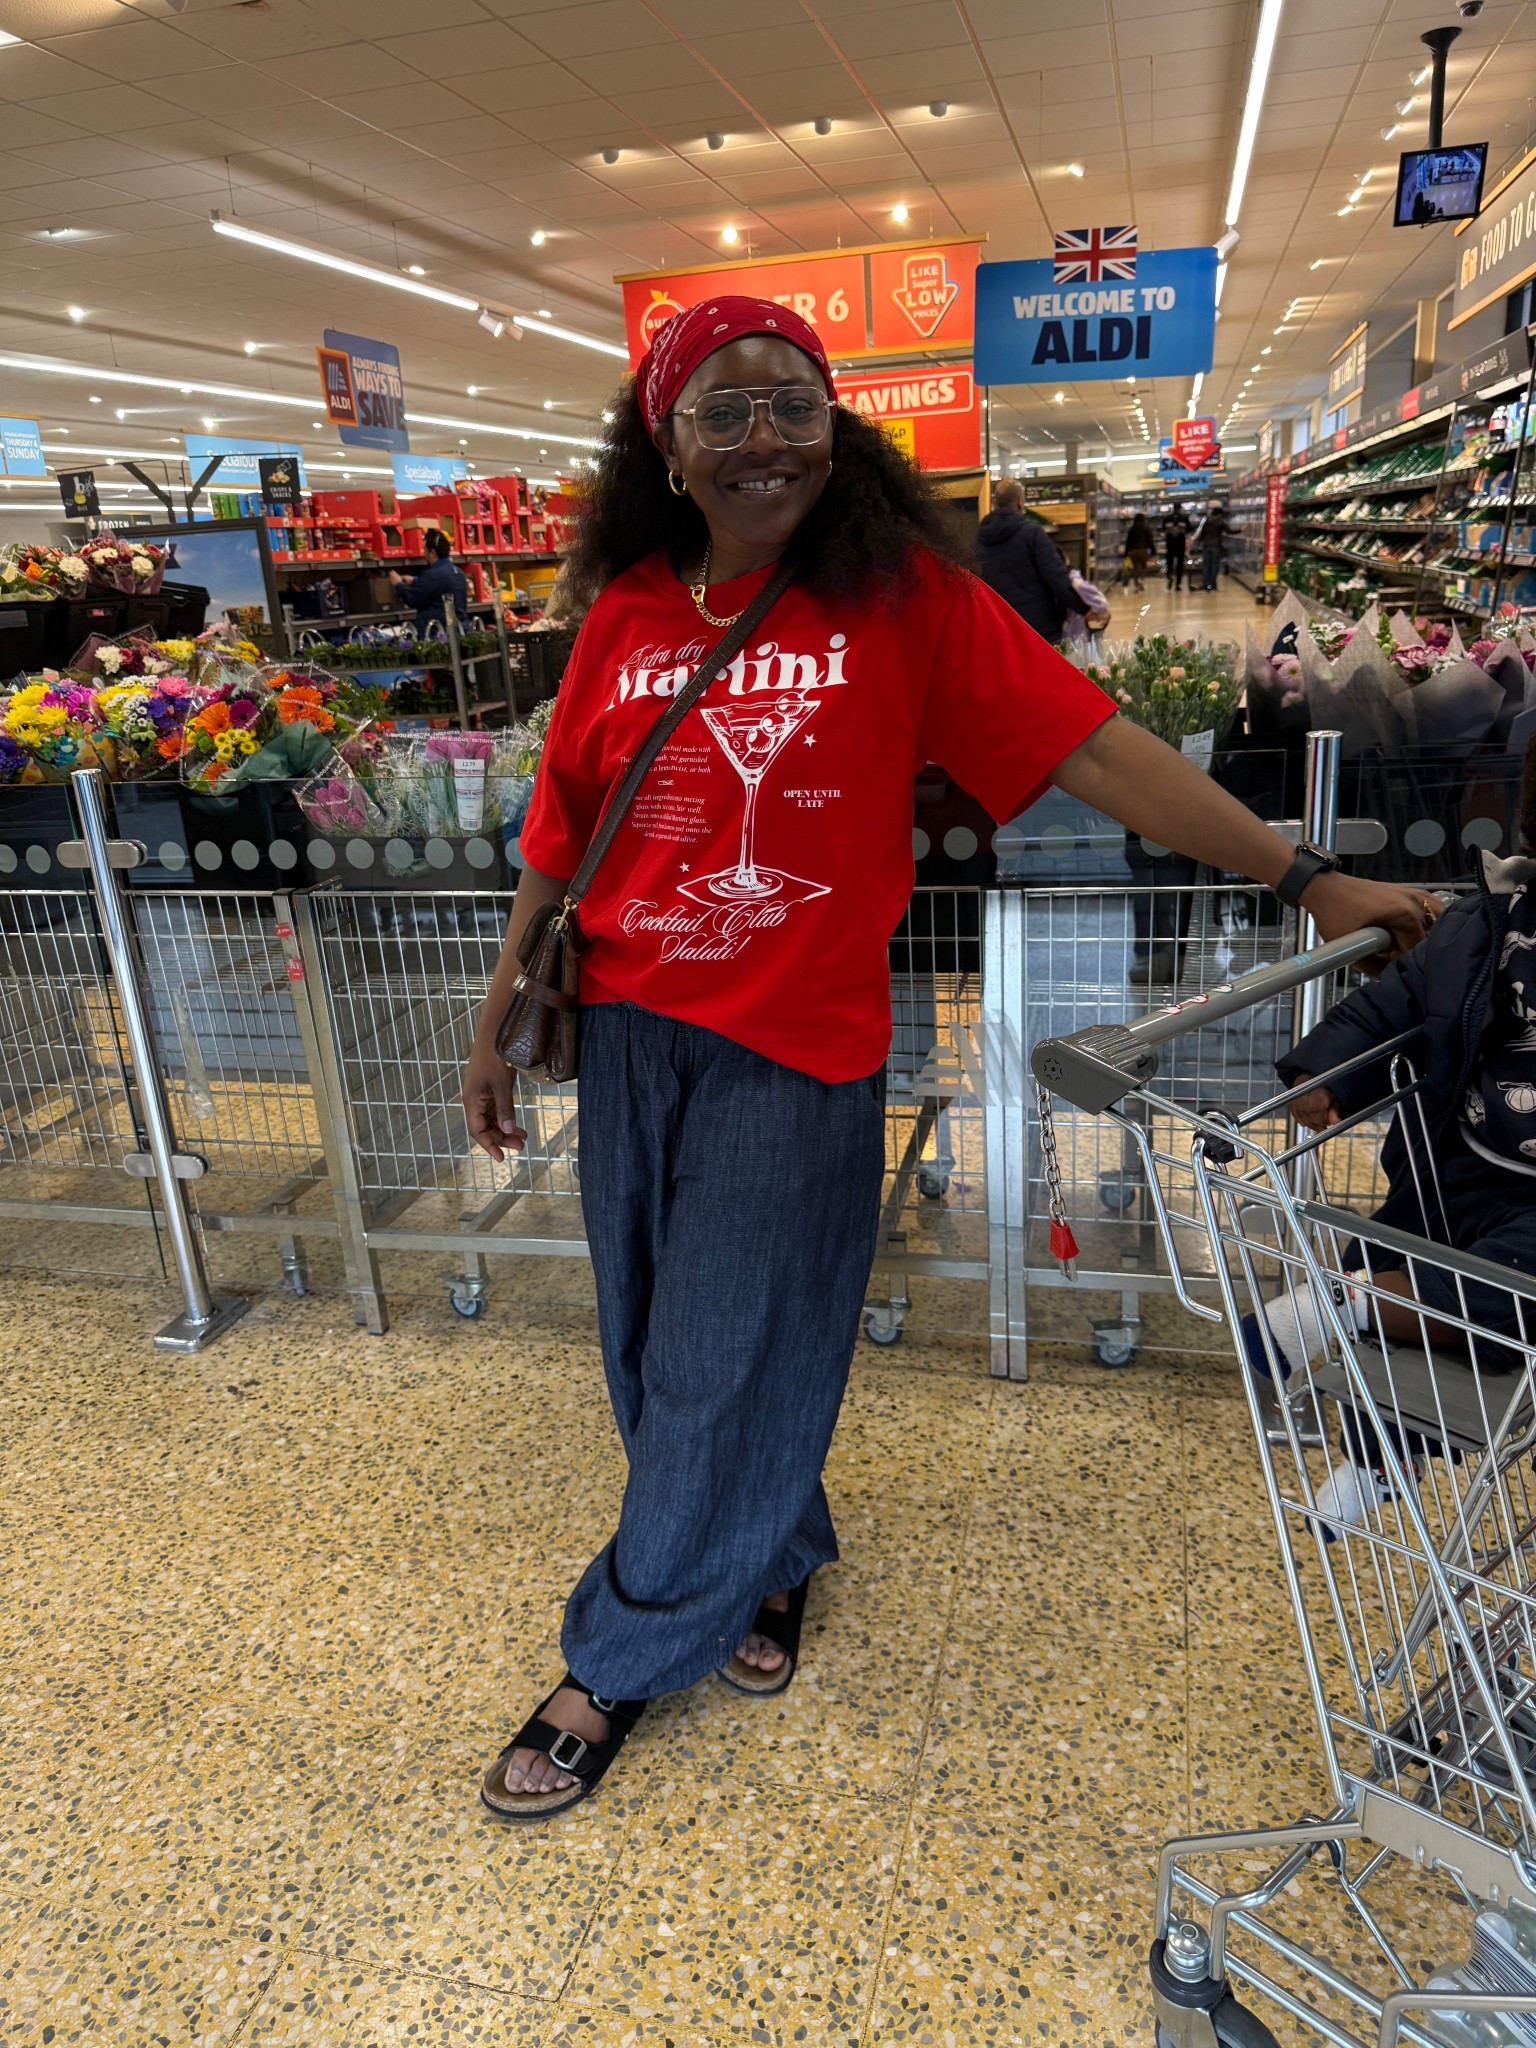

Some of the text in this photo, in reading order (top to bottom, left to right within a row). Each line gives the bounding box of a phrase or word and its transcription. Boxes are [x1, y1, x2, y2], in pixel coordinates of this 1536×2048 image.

[1480, 191, 1536, 274] FOOD TO G
[911, 265, 939, 278] LIKE
[912, 279, 938, 290] Super
[826, 288, 849, 322] 6
[906, 288, 948, 308] LOW
[1013, 286, 1176, 319] WELCOME TO
[912, 308, 939, 318] PRICES
[1031, 316, 1151, 365] ALDI
[352, 356, 377, 371] ALWAYS
[353, 368, 401, 398] WAYS TO
[331, 395, 352, 410] ALDI
[358, 391, 406, 431] SAVE
[1180, 424, 1209, 439] LIKE
[5, 437, 33, 447] THURSDAY
[7, 447, 40, 460] SUNDAY
[206, 449, 259, 472] Secialbuy
[675, 636, 708, 667] dry
[783, 789, 842, 799] OPEN UNTIL
[797, 799, 824, 808] LATE
[618, 899, 804, 940] Cocktail Club
[659, 933, 752, 963] Saluti!
